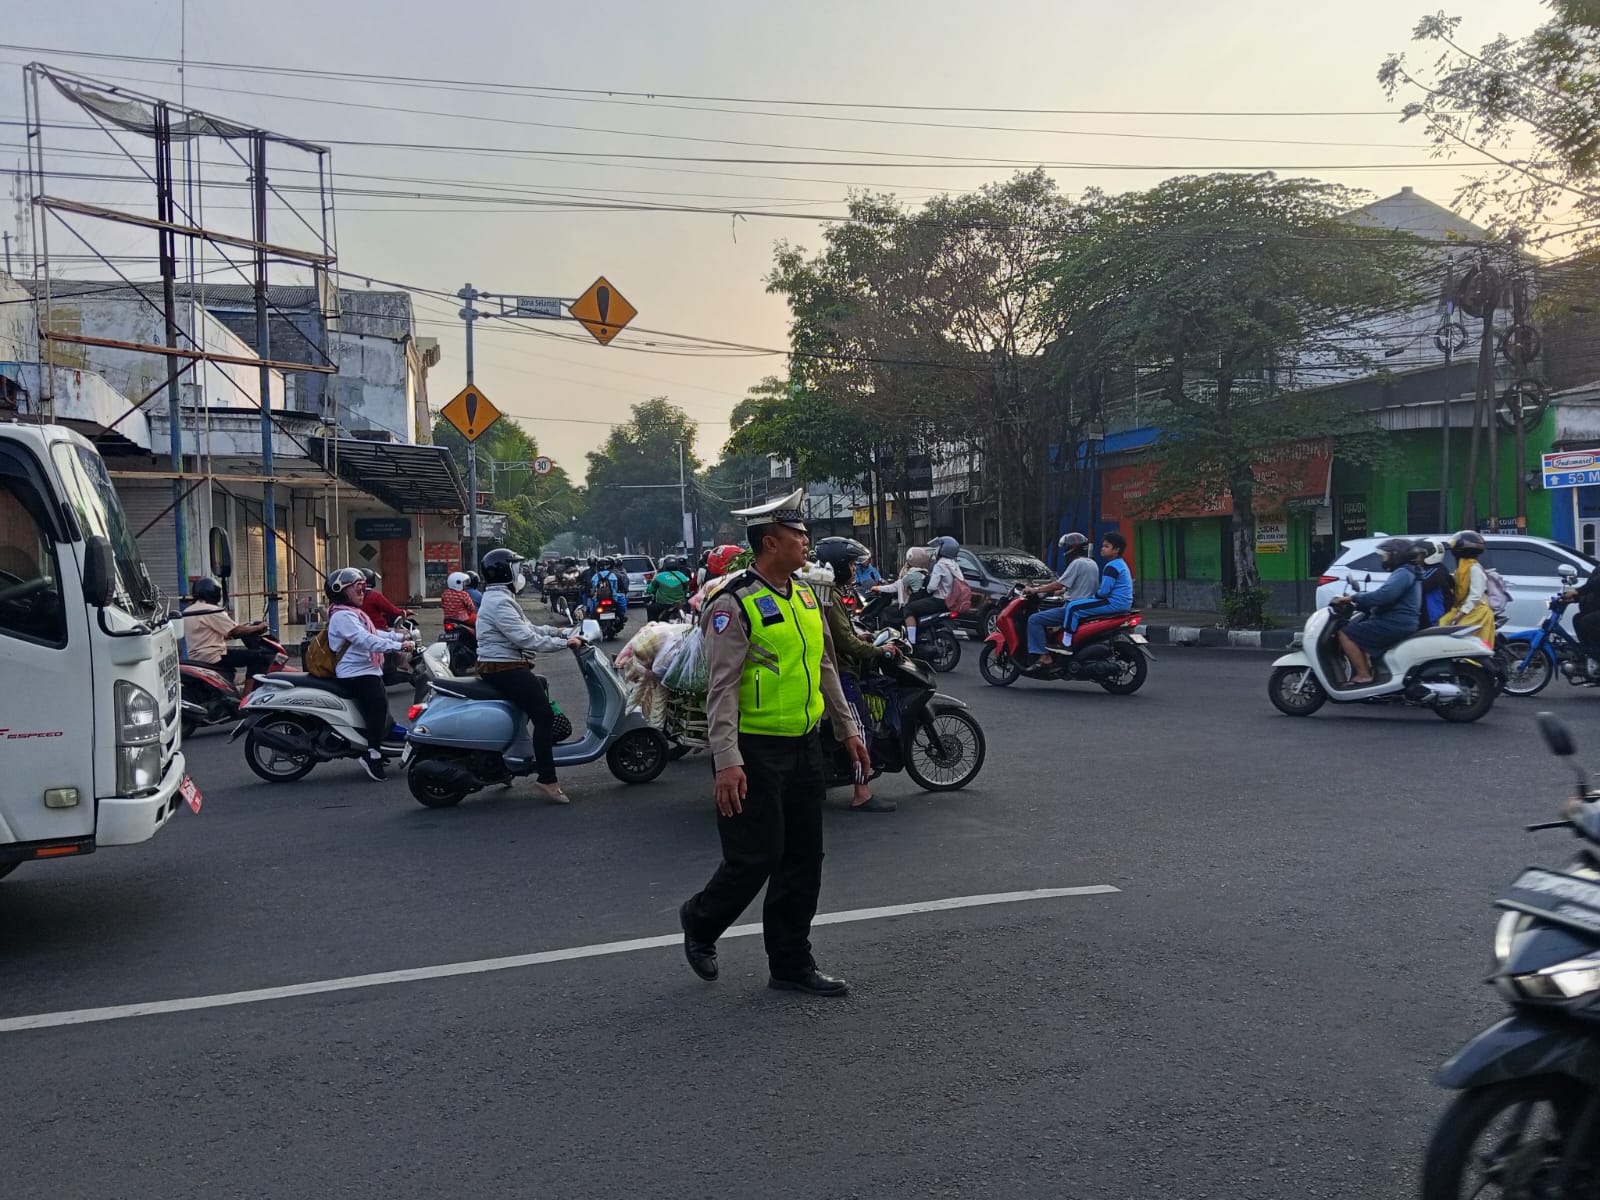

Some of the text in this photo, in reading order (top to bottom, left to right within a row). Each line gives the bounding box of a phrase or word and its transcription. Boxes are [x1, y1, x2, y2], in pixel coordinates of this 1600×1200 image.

[535, 299, 557, 307] Selamat
[537, 460, 546, 470] 30
[1555, 457, 1592, 466] Indomaret
[1568, 472, 1585, 484] 50
